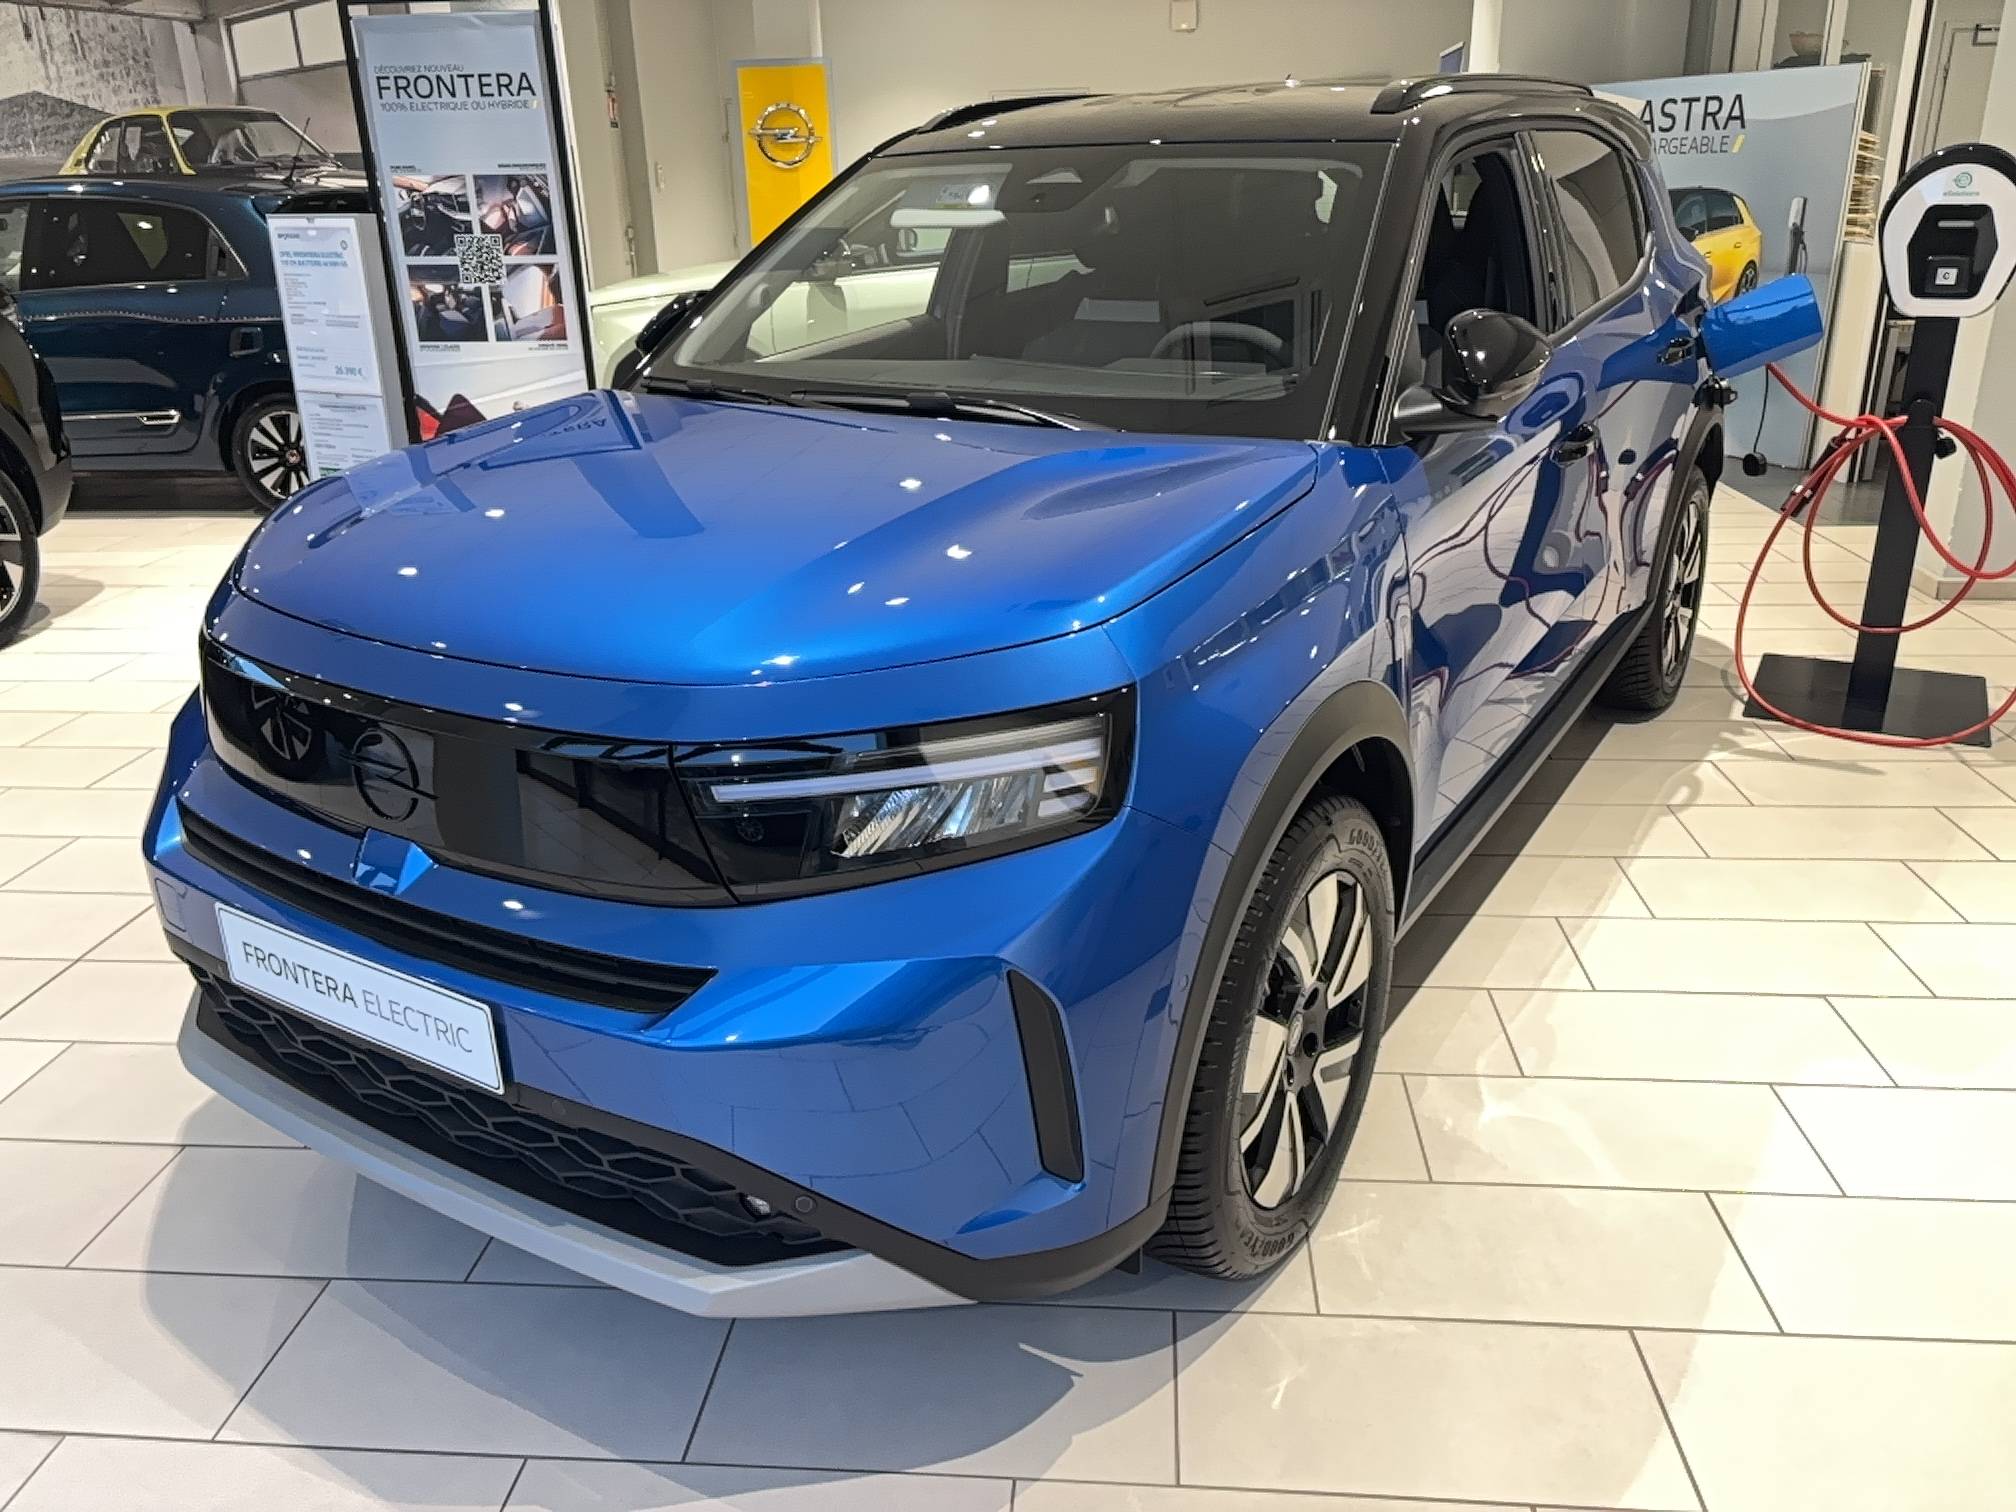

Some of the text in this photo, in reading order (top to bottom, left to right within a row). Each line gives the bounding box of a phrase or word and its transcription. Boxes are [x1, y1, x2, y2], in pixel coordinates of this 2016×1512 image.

[424, 63, 464, 73] NOUVEAU
[376, 72, 537, 100] FRONTERA
[380, 102, 408, 112] 100%
[470, 100, 486, 111] OU
[488, 99, 530, 110] HYBRIDE
[1640, 93, 1746, 133] ASTRA
[242, 941, 473, 1054] FRONTERA ELECTRIC
